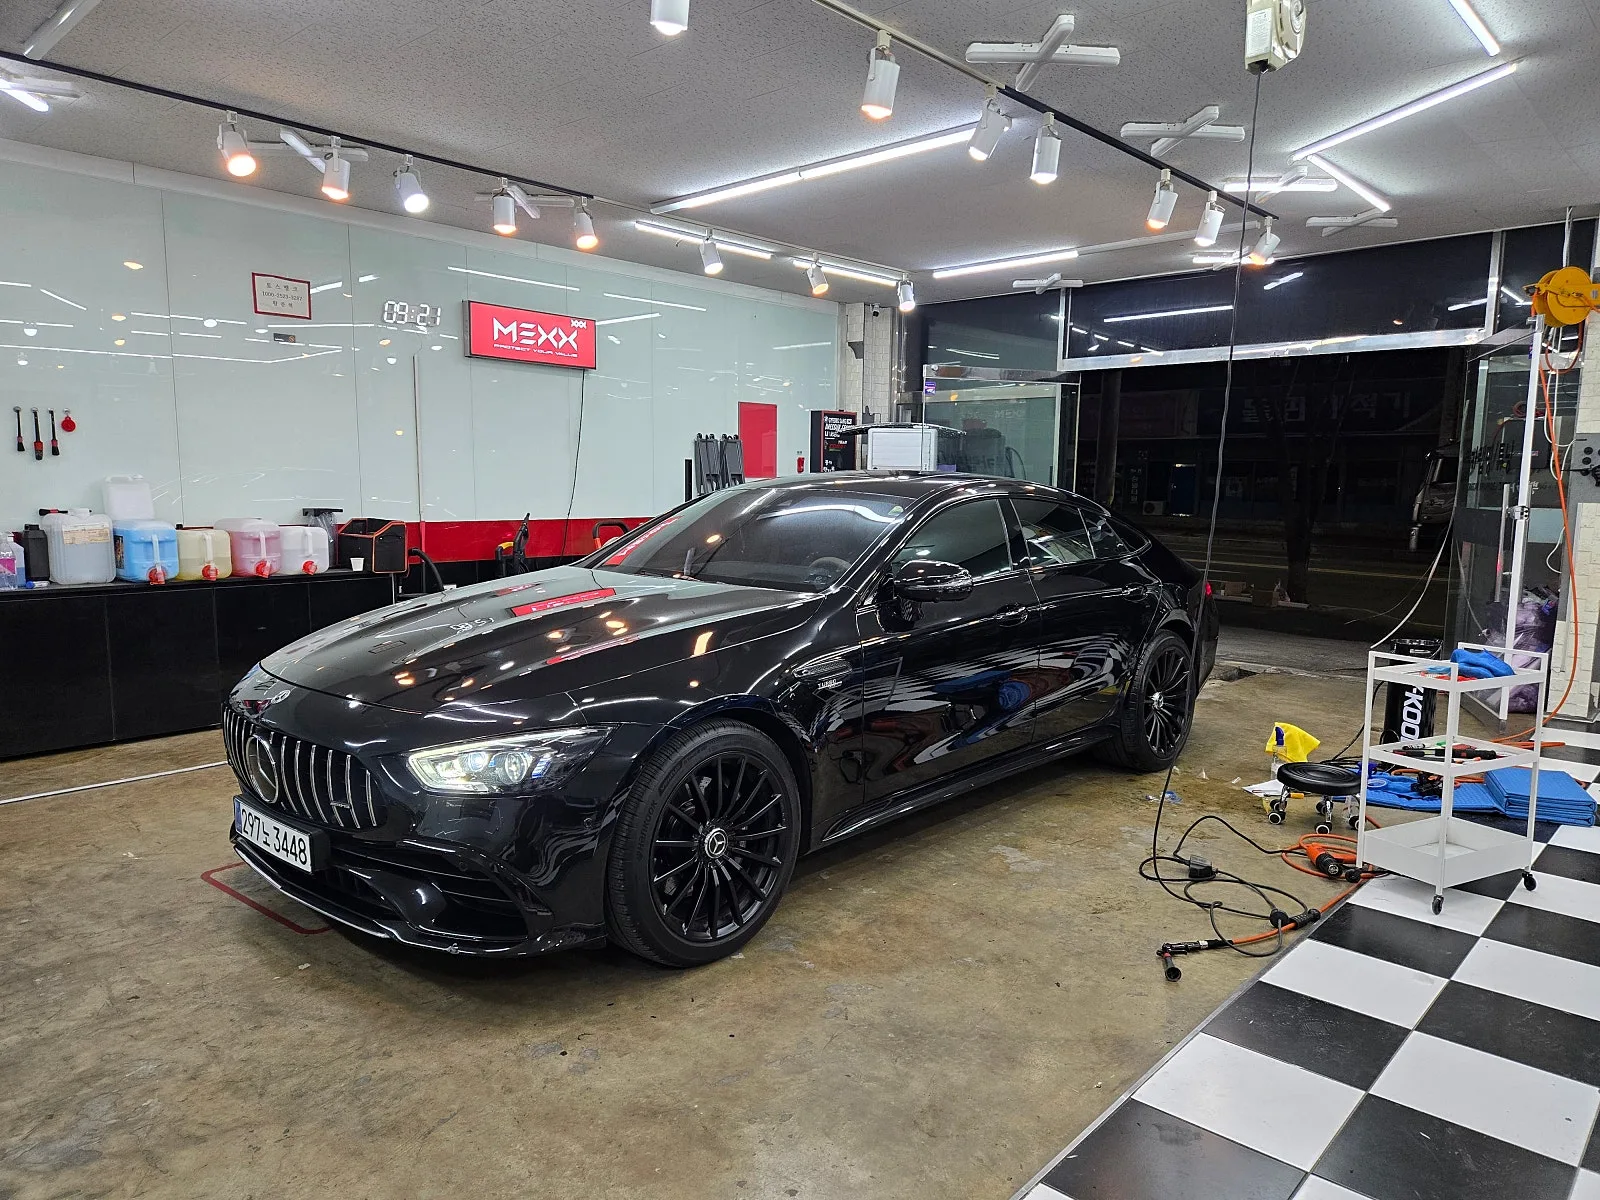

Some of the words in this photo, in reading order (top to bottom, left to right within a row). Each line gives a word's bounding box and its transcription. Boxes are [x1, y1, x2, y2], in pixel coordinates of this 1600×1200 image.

[384, 301, 441, 326] 09:21
[492, 317, 578, 352] MEXX
[532, 347, 554, 356] YOUR
[1400, 686, 1424, 742] -KOO
[241, 808, 271, 847] 297노
[272, 825, 308, 866] 3448
